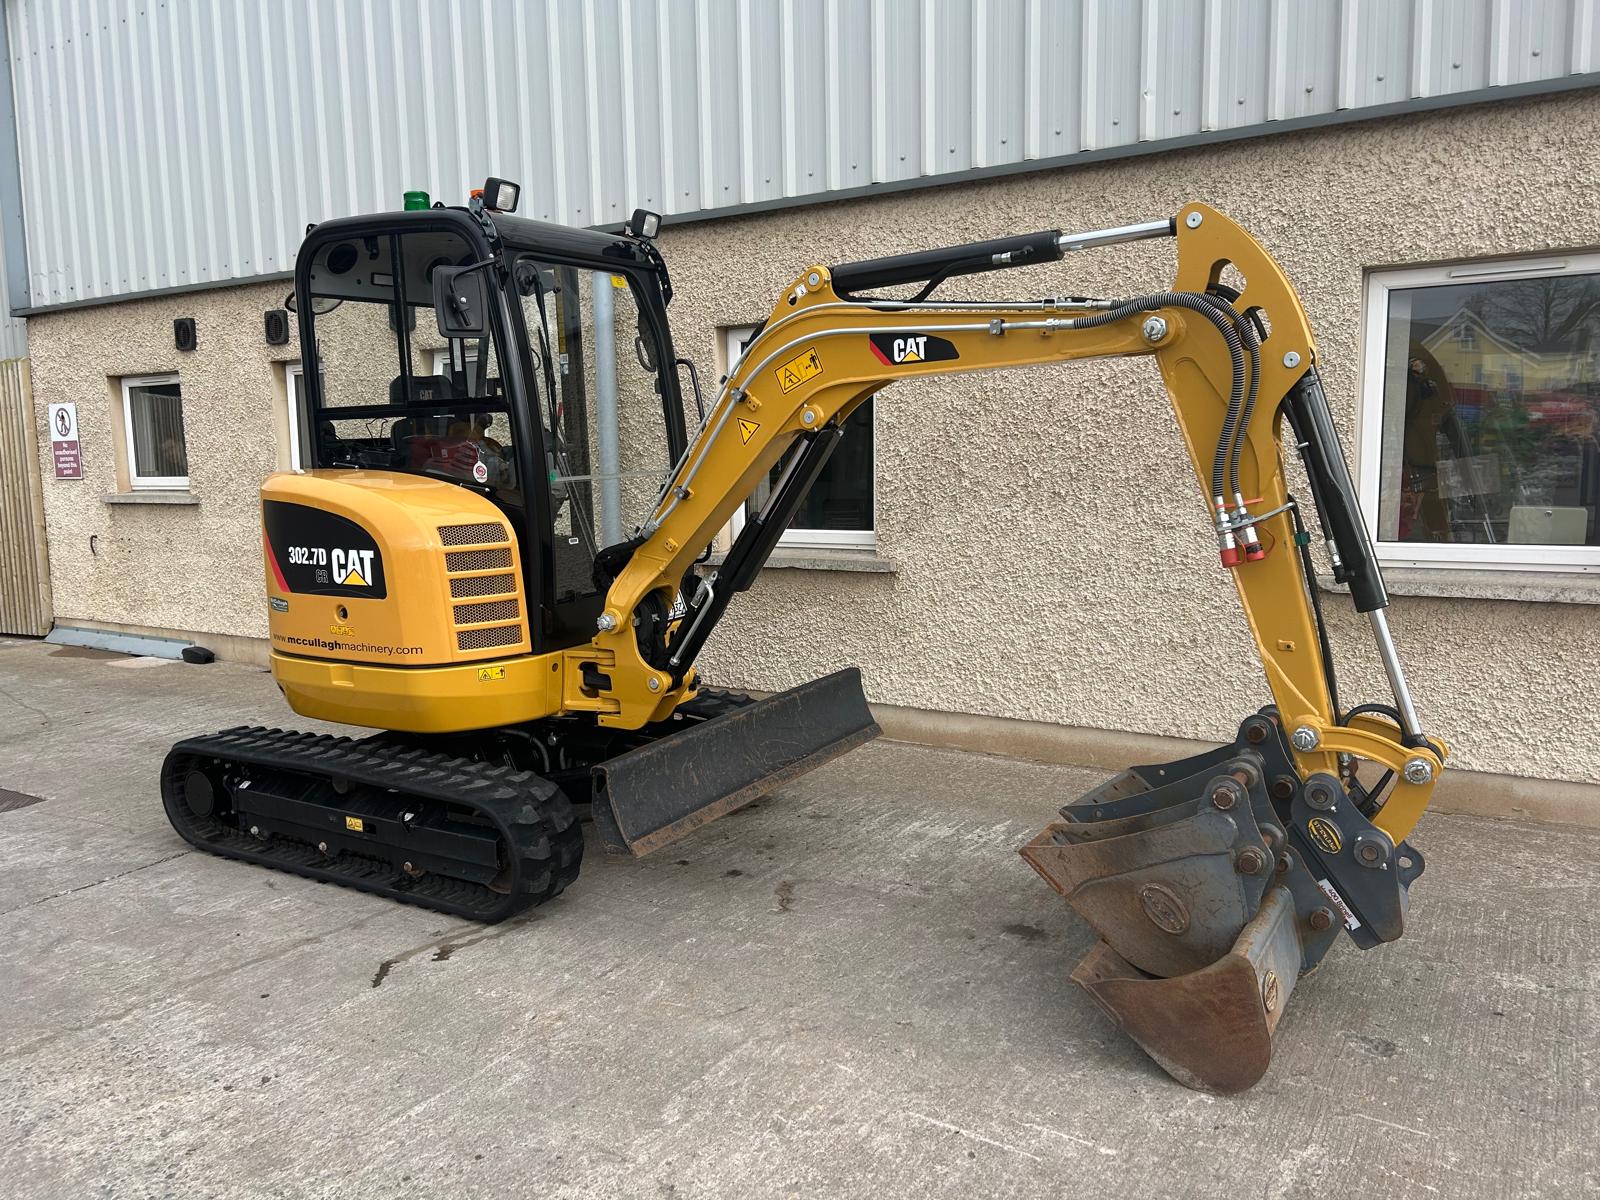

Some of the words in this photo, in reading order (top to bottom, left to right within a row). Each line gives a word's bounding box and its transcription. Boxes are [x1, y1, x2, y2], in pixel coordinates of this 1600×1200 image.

[893, 336, 927, 363] CAT
[288, 546, 327, 566] 302.7D
[331, 548, 375, 587] CAT
[273, 633, 423, 656] www.mccullaghmachinery.com
